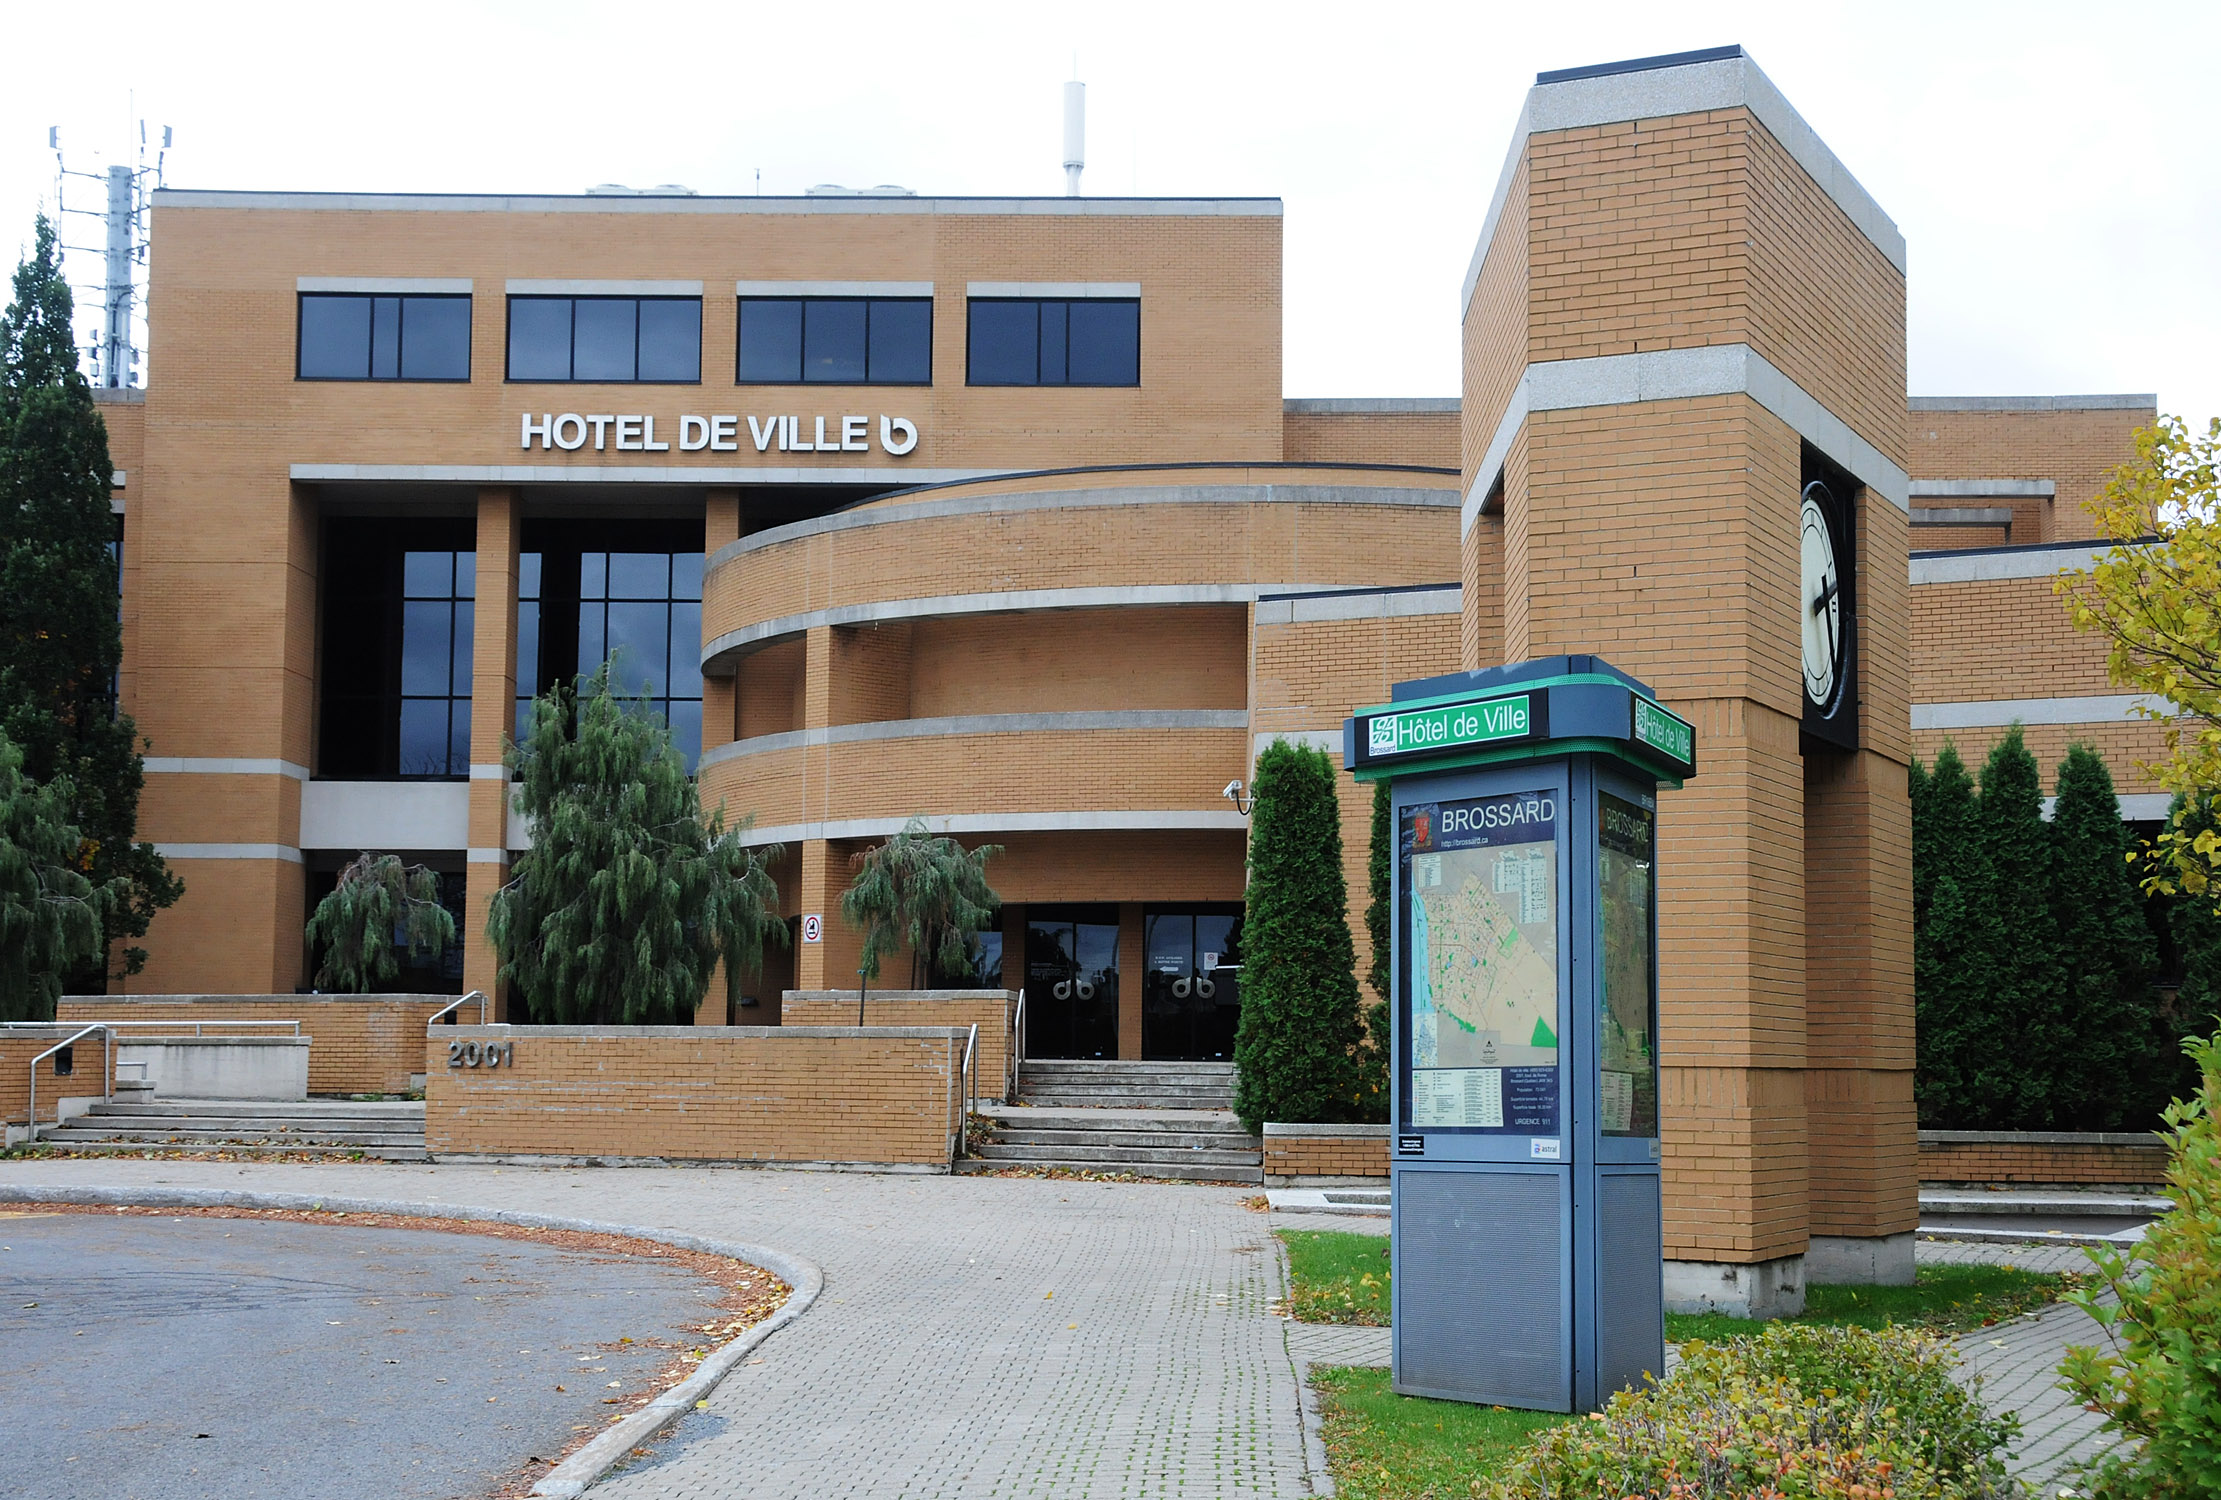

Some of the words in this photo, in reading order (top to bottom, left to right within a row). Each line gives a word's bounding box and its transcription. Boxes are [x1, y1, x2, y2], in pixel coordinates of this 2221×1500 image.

[521, 413, 669, 451] HOTEL
[679, 414, 738, 451] DE
[747, 415, 869, 452] VILLE
[1399, 714, 1448, 746] Hôtel
[1453, 711, 1479, 738] de
[1483, 704, 1526, 733] Ville
[1646, 711, 1665, 745] Hôtel
[1665, 723, 1675, 750] de
[1675, 727, 1690, 758] Ville
[1370, 745, 1396, 755] Brossard
[1441, 799, 1555, 833] BROSSARD
[1606, 807, 1649, 843] BROSSARD
[447, 1040, 513, 1068] 2001
[1514, 1117, 1541, 1126] URGENCE
[1541, 1117, 1551, 1126] 911
[1541, 1145, 1558, 1153] astral
